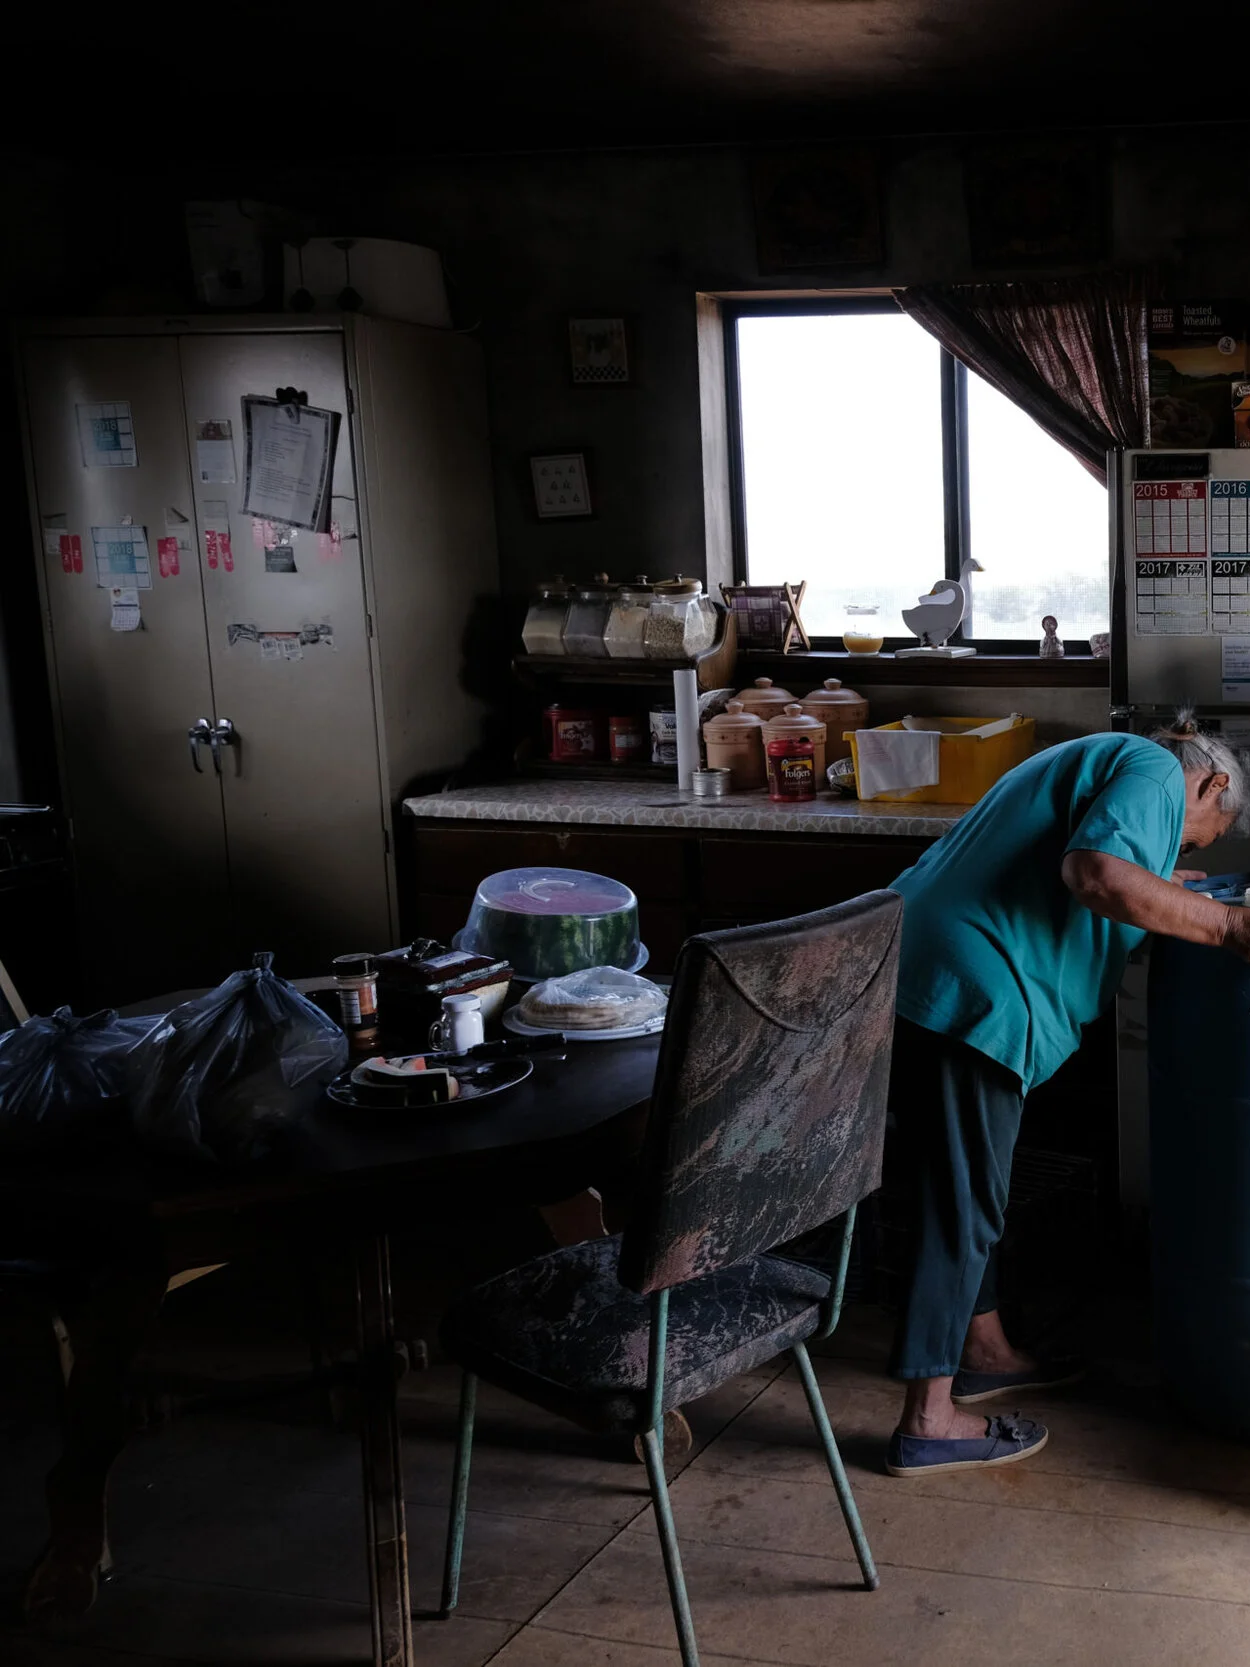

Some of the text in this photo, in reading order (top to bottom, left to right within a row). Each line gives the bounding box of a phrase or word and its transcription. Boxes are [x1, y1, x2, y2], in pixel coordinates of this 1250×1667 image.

[1135, 484, 1168, 497] 2015
[1213, 482, 1247, 495] 2016
[110, 544, 133, 554] 2018
[1138, 561, 1170, 574] 2017
[1214, 561, 1247, 574] 2017
[784, 768, 811, 779] Folgers
